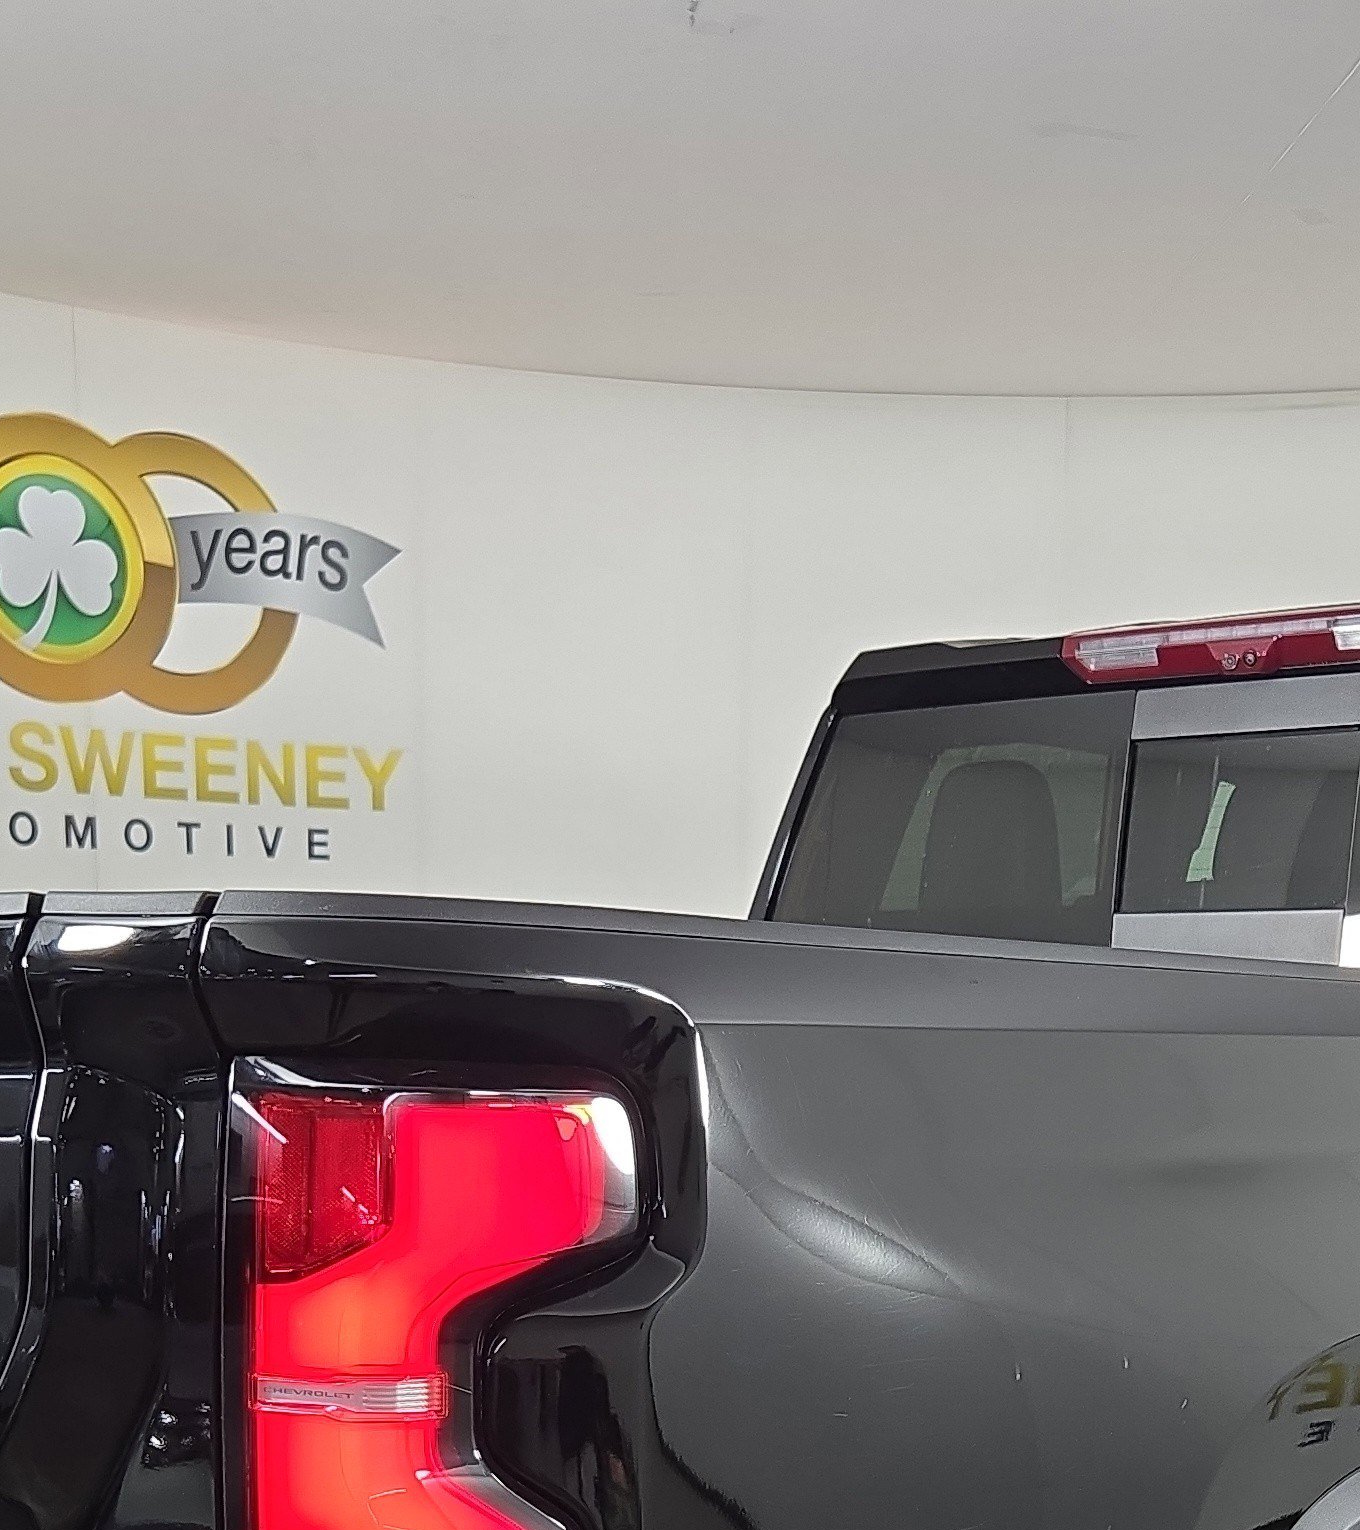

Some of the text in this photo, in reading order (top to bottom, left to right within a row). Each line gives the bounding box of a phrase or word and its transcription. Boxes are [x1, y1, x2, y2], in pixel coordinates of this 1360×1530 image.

[190, 525, 351, 593] years
[7, 719, 404, 812] SWEENEY
[263, 1385, 355, 1400] CHEVROLET
